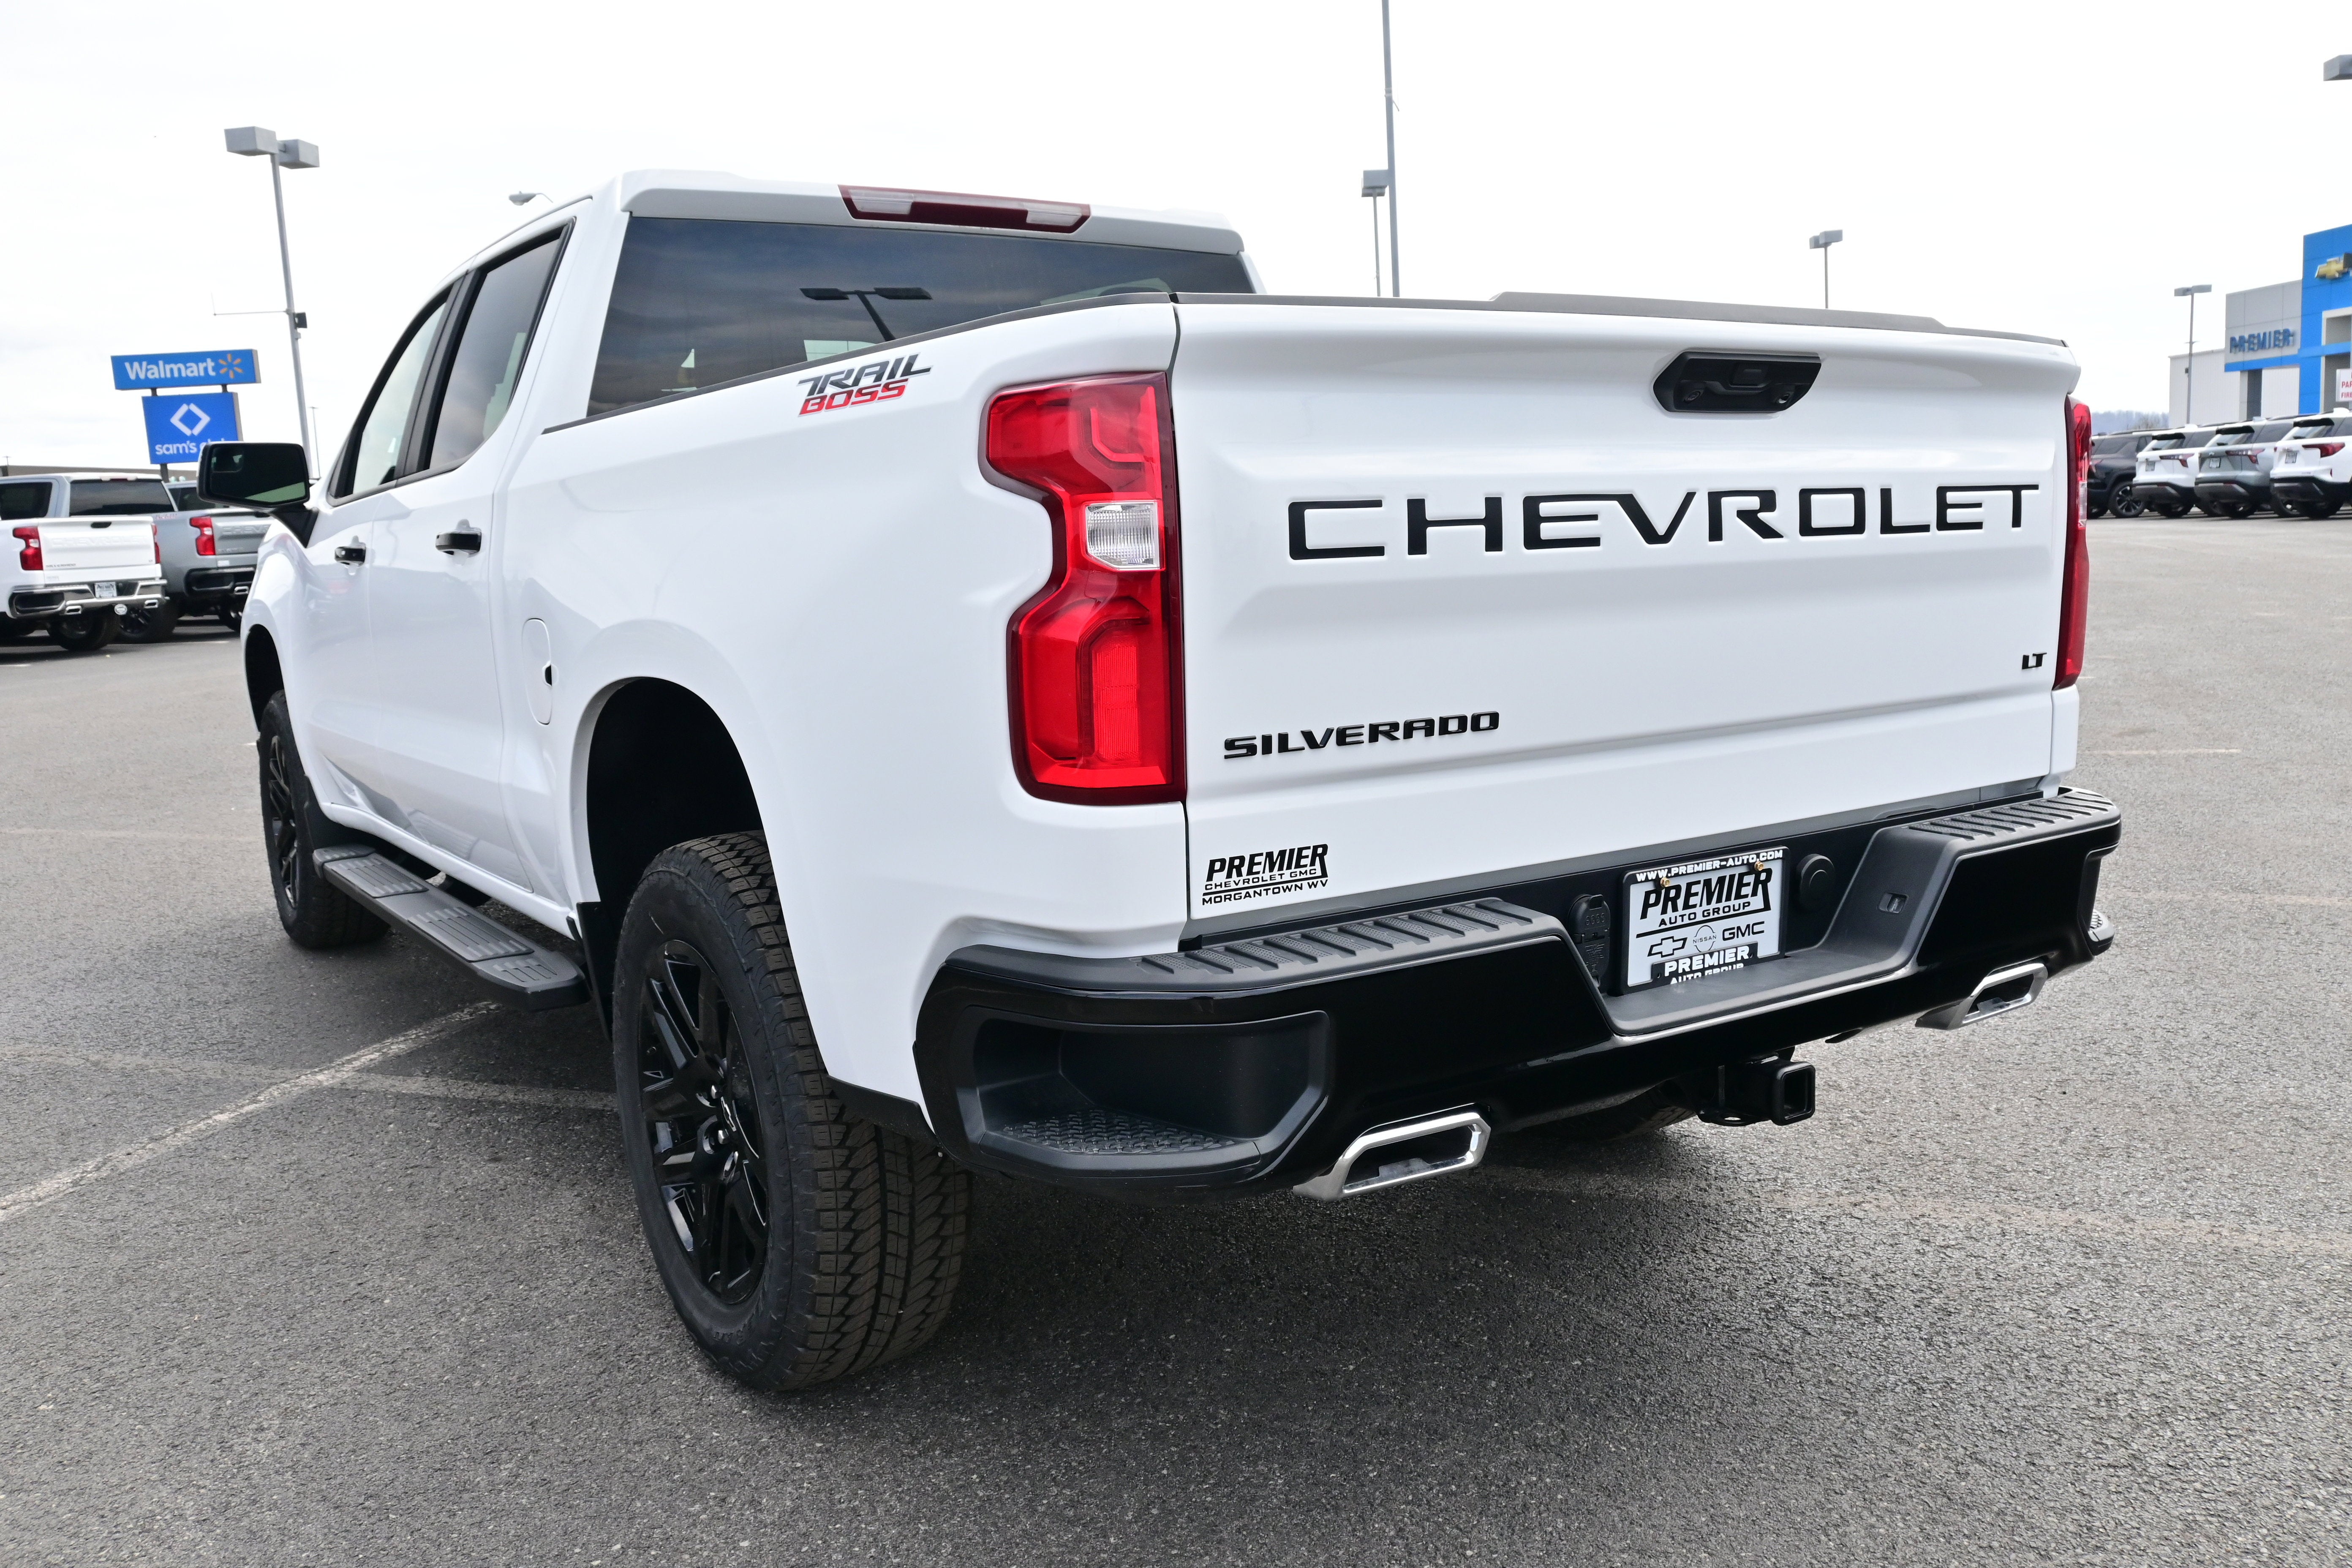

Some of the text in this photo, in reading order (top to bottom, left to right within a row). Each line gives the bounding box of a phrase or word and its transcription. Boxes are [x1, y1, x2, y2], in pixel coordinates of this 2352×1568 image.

[2230, 328, 2292, 354] PREMIER
[125, 358, 216, 379] Walmart
[797, 352, 933, 397] TRAIL
[798, 378, 909, 417] BOSS
[155, 441, 197, 455] sam's
[1288, 485, 2039, 560] CHEVROLET
[2022, 653, 2047, 670] LT
[1224, 712, 1499, 759] SILVERADO
[1206, 844, 1328, 882] PREMIER
[1636, 849, 1783, 882] WWW.PREMIER-AUTO.COM
[1202, 879, 1328, 905] MORGANTOWN WV
[1205, 868, 1317, 890] CHEVROLET GMC
[1640, 868, 1772, 920] PREMIER
[1658, 901, 1751, 927] AUTO GROUP
[1693, 921, 1765, 944] NISSAN GMC
[1665, 946, 1750, 977] PREMIER
